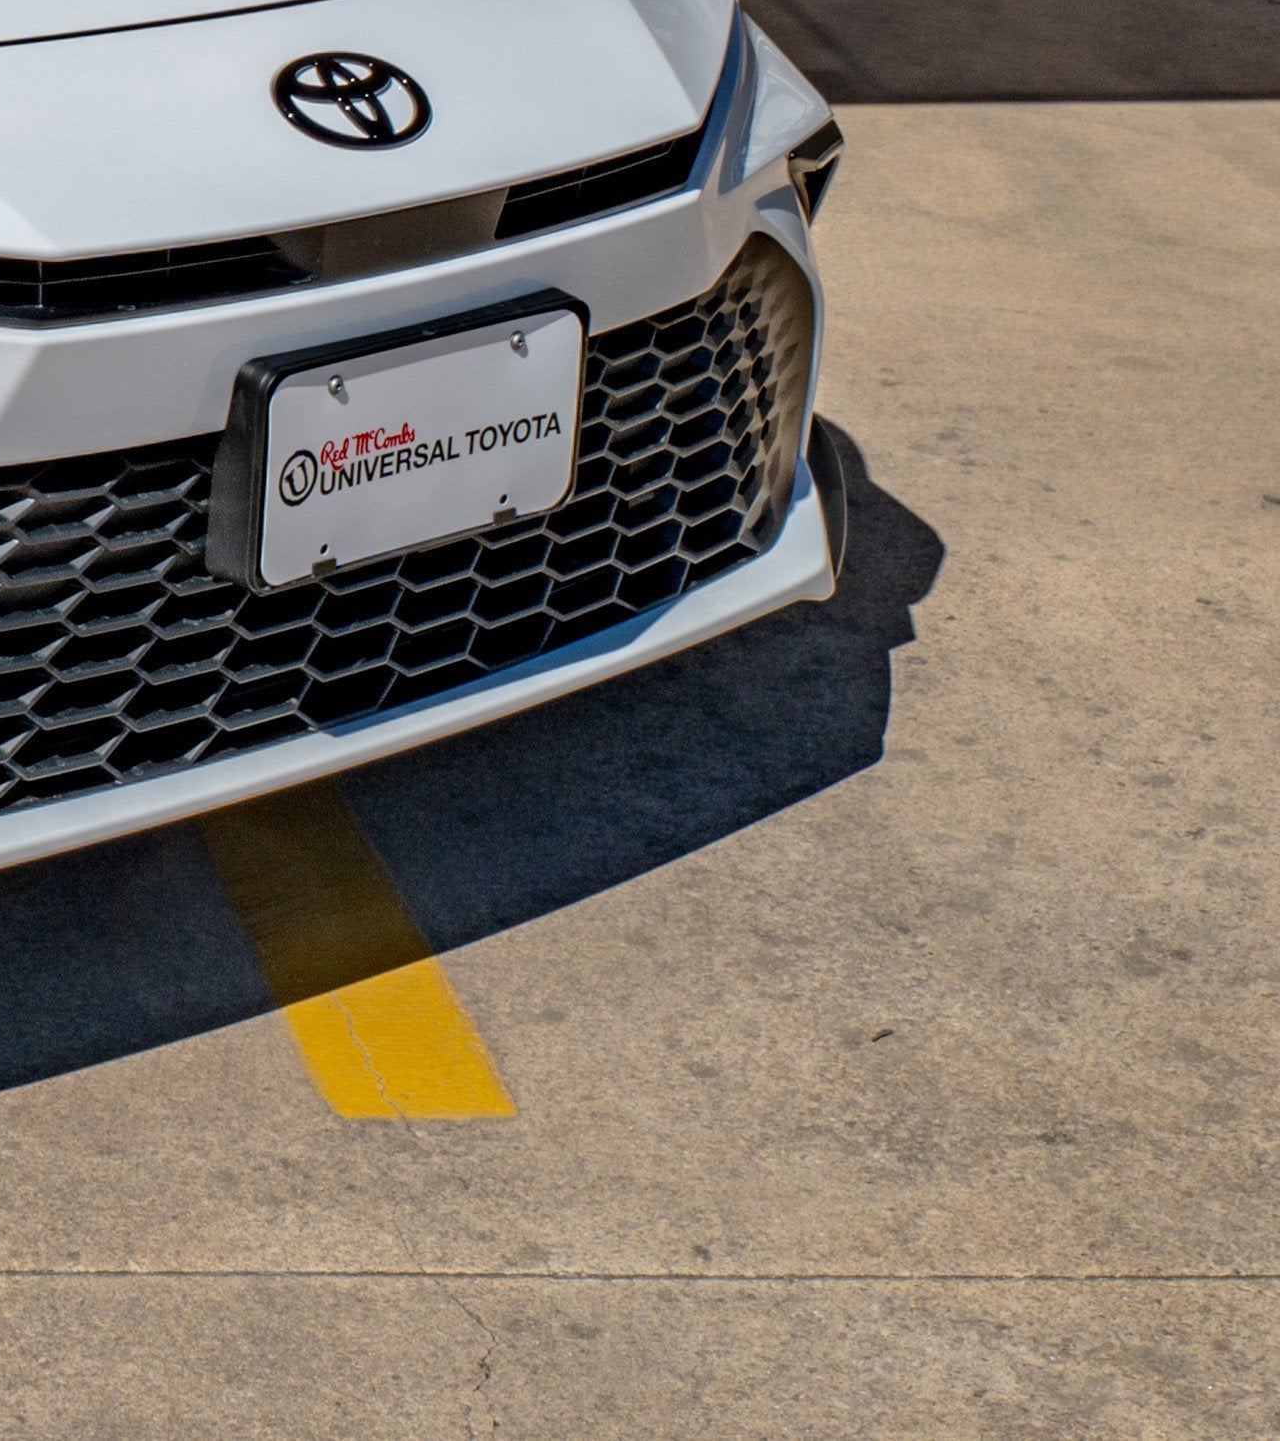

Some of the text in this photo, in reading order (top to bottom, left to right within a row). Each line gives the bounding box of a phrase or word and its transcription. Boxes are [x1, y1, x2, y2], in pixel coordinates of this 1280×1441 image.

[320, 412, 561, 496] UNIVERSAL TOYOTA
[321, 438, 349, 471] Red
